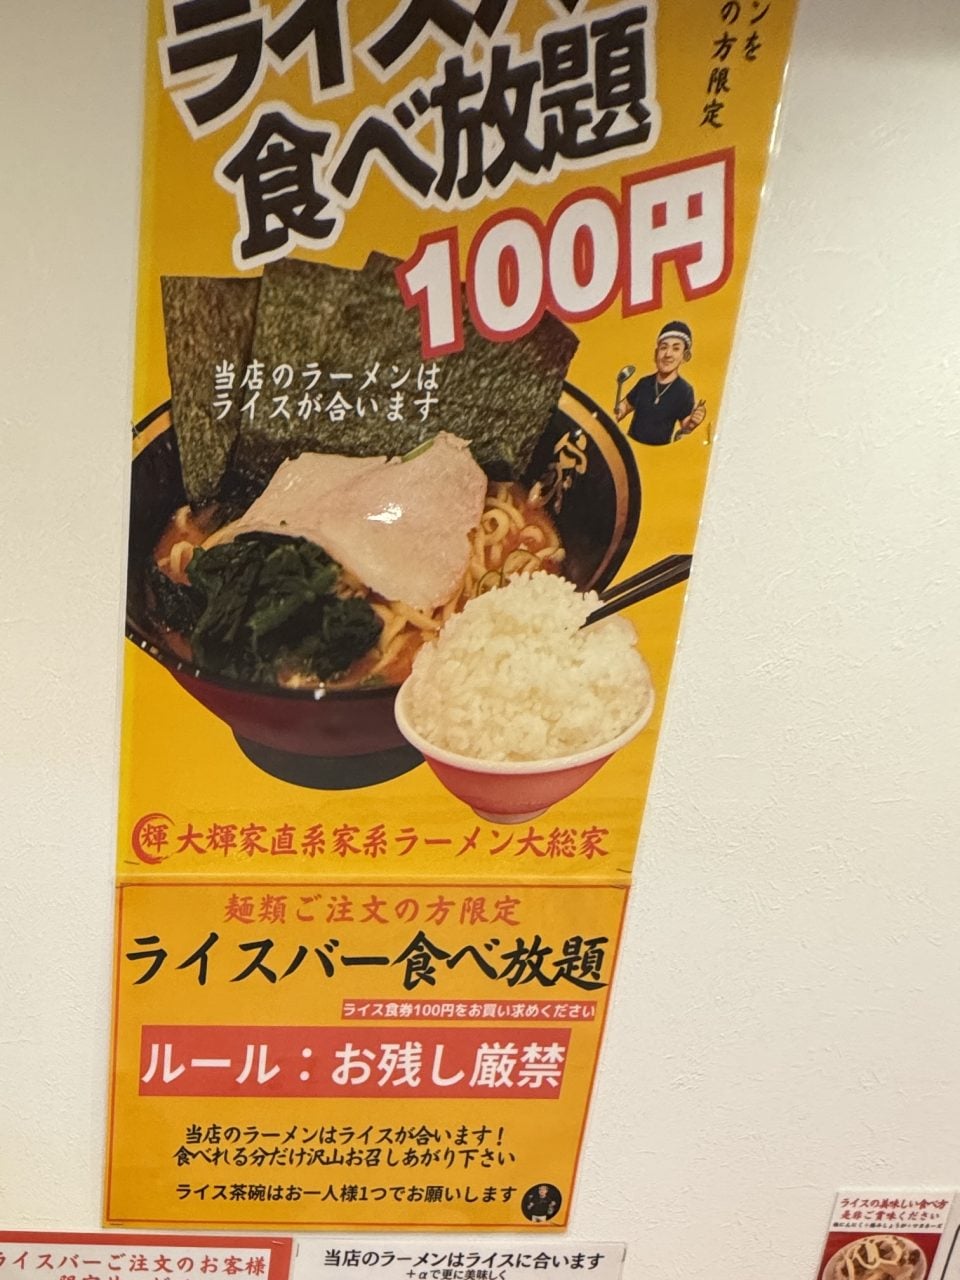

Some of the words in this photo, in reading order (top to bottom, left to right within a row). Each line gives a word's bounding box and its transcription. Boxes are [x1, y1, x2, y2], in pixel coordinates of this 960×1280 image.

[167, 0, 581, 127] ライス
[222, 8, 652, 262] 食べ放題
[396, 147, 737, 358] 100円
[213, 361, 441, 392] 当店のラーメンは
[213, 391, 441, 423] ライスが合います
[178, 823, 610, 860] 大輝家直系家系ラーメン大総家
[224, 894, 521, 927] 麺類ご注文の方限定
[126, 930, 610, 992] ライスバー食べ放題
[342, 1001, 596, 1020] ライス食券100円をお買い求めください
[141, 1040, 567, 1090] ルール：お残し厳禁
[184, 1124, 506, 1148] 当店のラーメンはライスが合います！
[172, 1146, 517, 1170] 食べれる分だけ沢山お召しあがり下さい
[175, 1183, 518, 1204] ライス茶碗はお一人様1つでお願いします
[323, 1249, 605, 1271] 当店のラーメンはライスに合います
